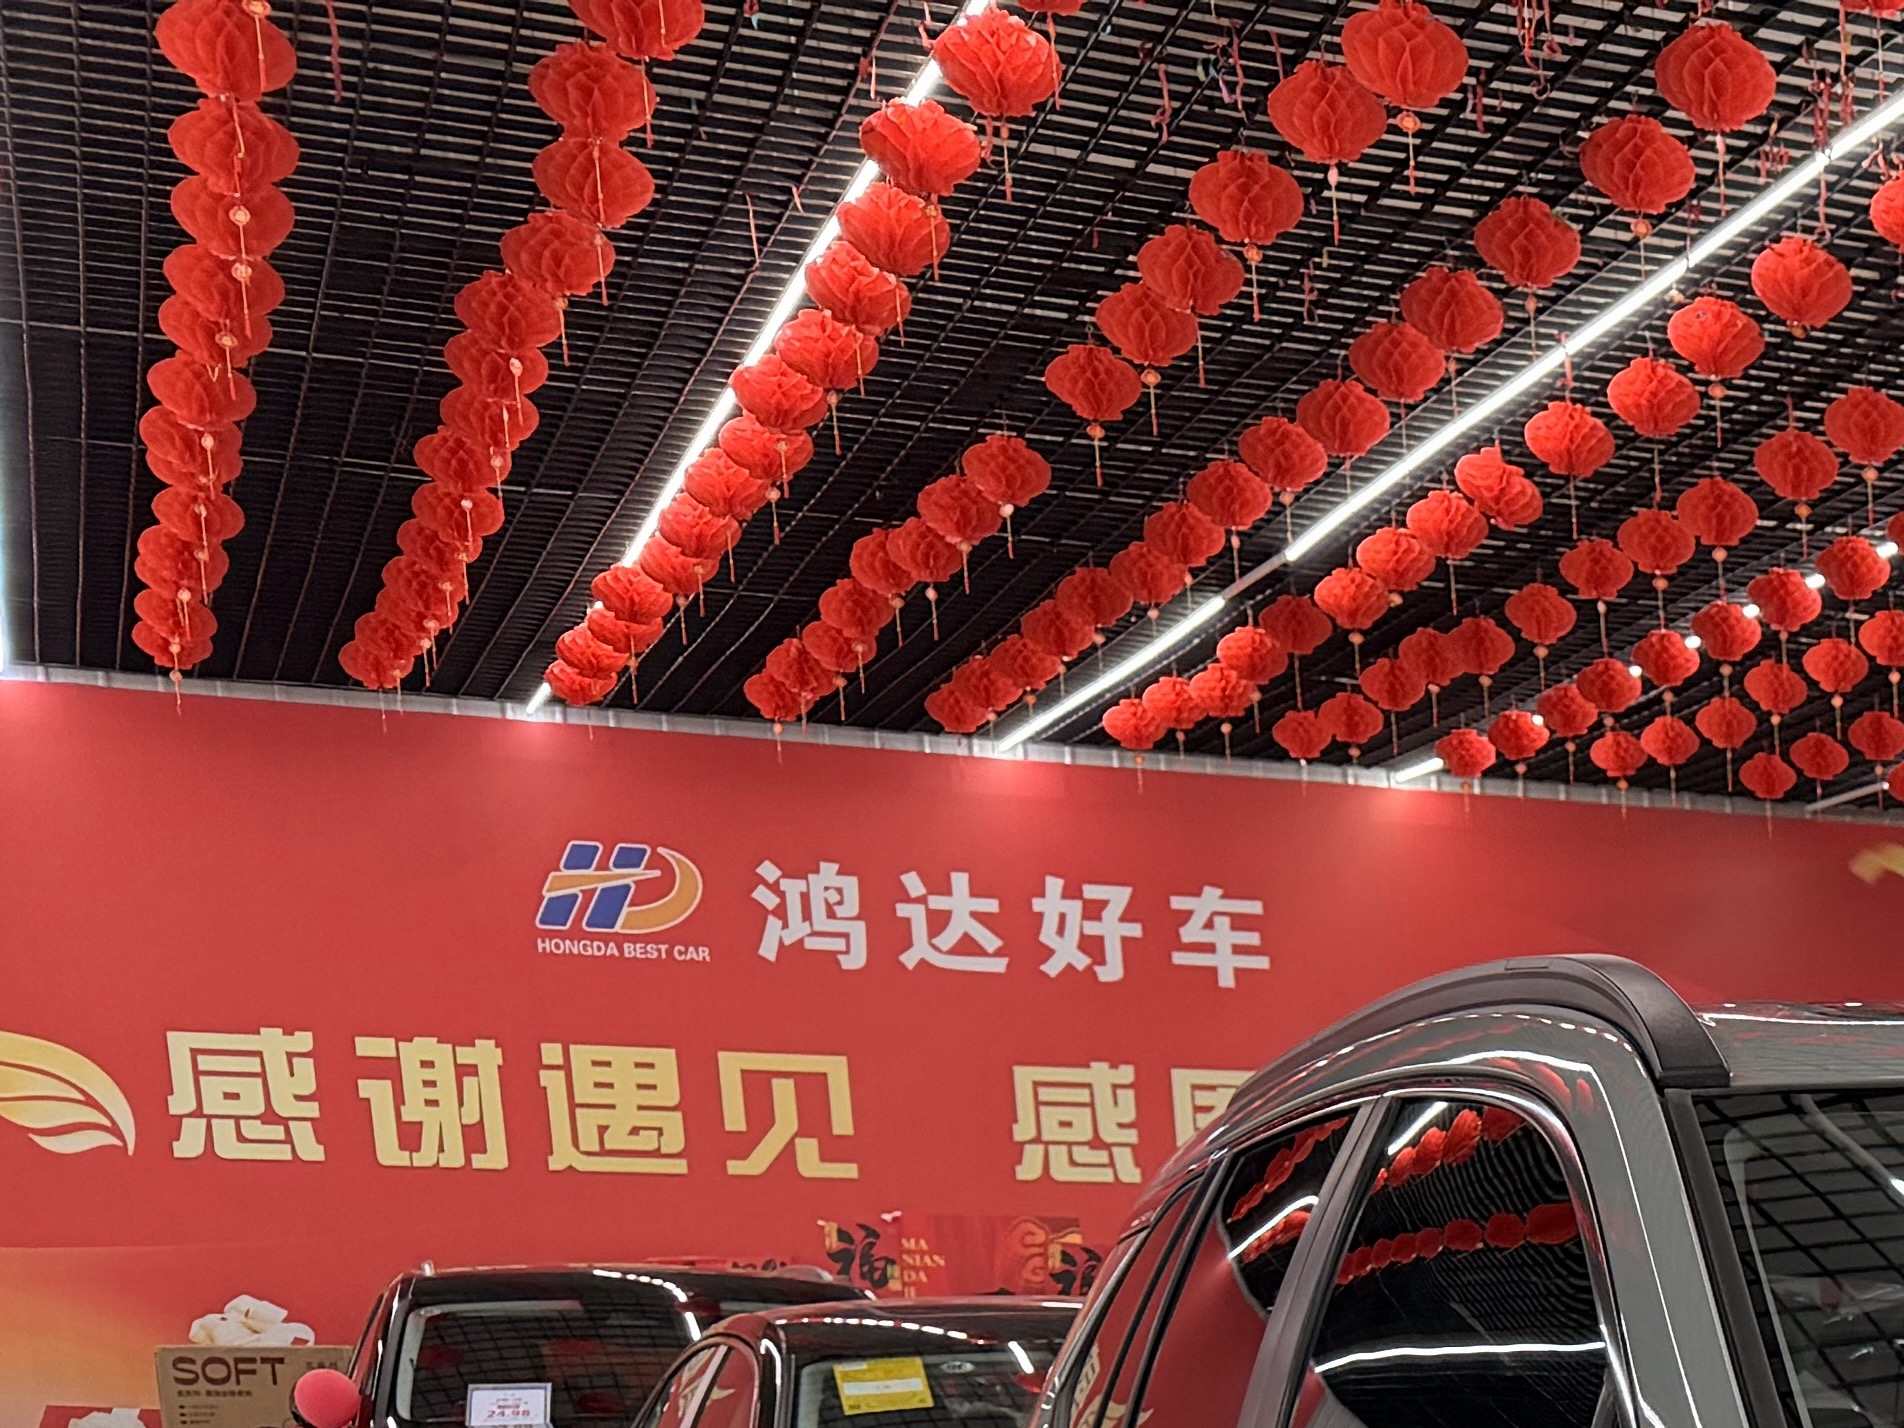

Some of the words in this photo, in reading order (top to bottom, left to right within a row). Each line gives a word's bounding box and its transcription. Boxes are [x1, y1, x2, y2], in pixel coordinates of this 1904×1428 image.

[537, 937, 619, 958] HONGDA
[623, 942, 669, 960] BEST
[673, 945, 711, 962] CAR
[751, 859, 1271, 989] 鸿达好车
[166, 1026, 860, 1180] 感谢遇见
[172, 1356, 285, 1386] SOFT
